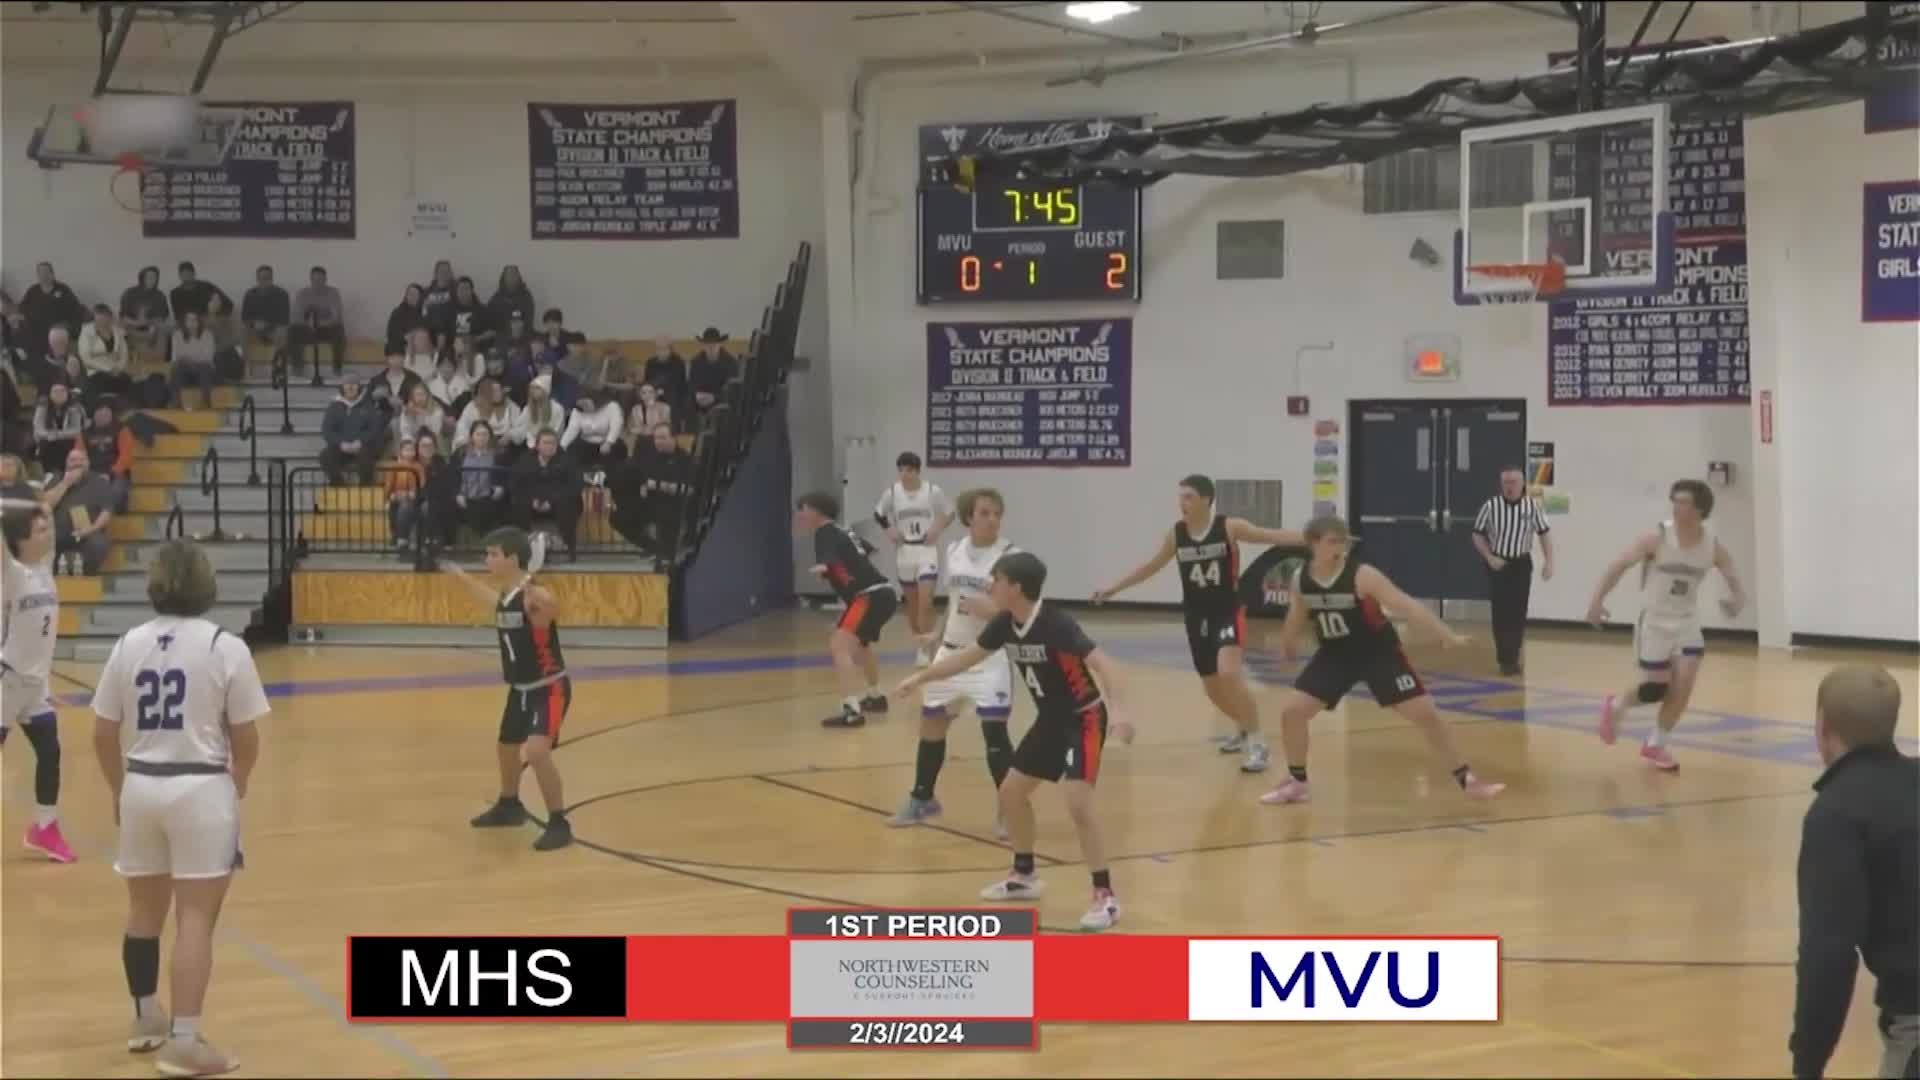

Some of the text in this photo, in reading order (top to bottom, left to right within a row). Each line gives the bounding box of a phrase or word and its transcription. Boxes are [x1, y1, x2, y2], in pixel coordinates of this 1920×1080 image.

[584, 109, 680, 127] VERMONT
[232, 126, 328, 141] HAMPIONS
[552, 126, 713, 144] STATE CHAMPIONS
[556, 147, 604, 162] DIVISION
[622, 147, 661, 161] TRACK
[674, 145, 710, 161] FIELD
[633, 193, 664, 206] TEAM
[1004, 188, 1077, 224] 7:45
[936, 231, 1127, 251] MVU GUEST
[1007, 242, 1047, 255] PERIOD
[1605, 246, 1719, 269] VERONT
[960, 255, 982, 291] 0
[1028, 260, 1036, 286] 1
[1105, 252, 1127, 289] 2
[1710, 285, 1748, 304] FIELD
[1675, 311, 1711, 326] RELAY
[979, 327, 1081, 346] VERMONT
[950, 345, 1110, 366] STATE CHAMPIONS
[951, 368, 999, 385] DIVISION
[1004, 367, 1014, 383] II
[1019, 366, 1057, 383] TRACK
[1072, 365, 1108, 383] FIELD
[1189, 560, 1221, 589] 44
[1317, 610, 1349, 639] 10
[1024, 665, 1045, 699] 4
[135, 668, 187, 731] 22
